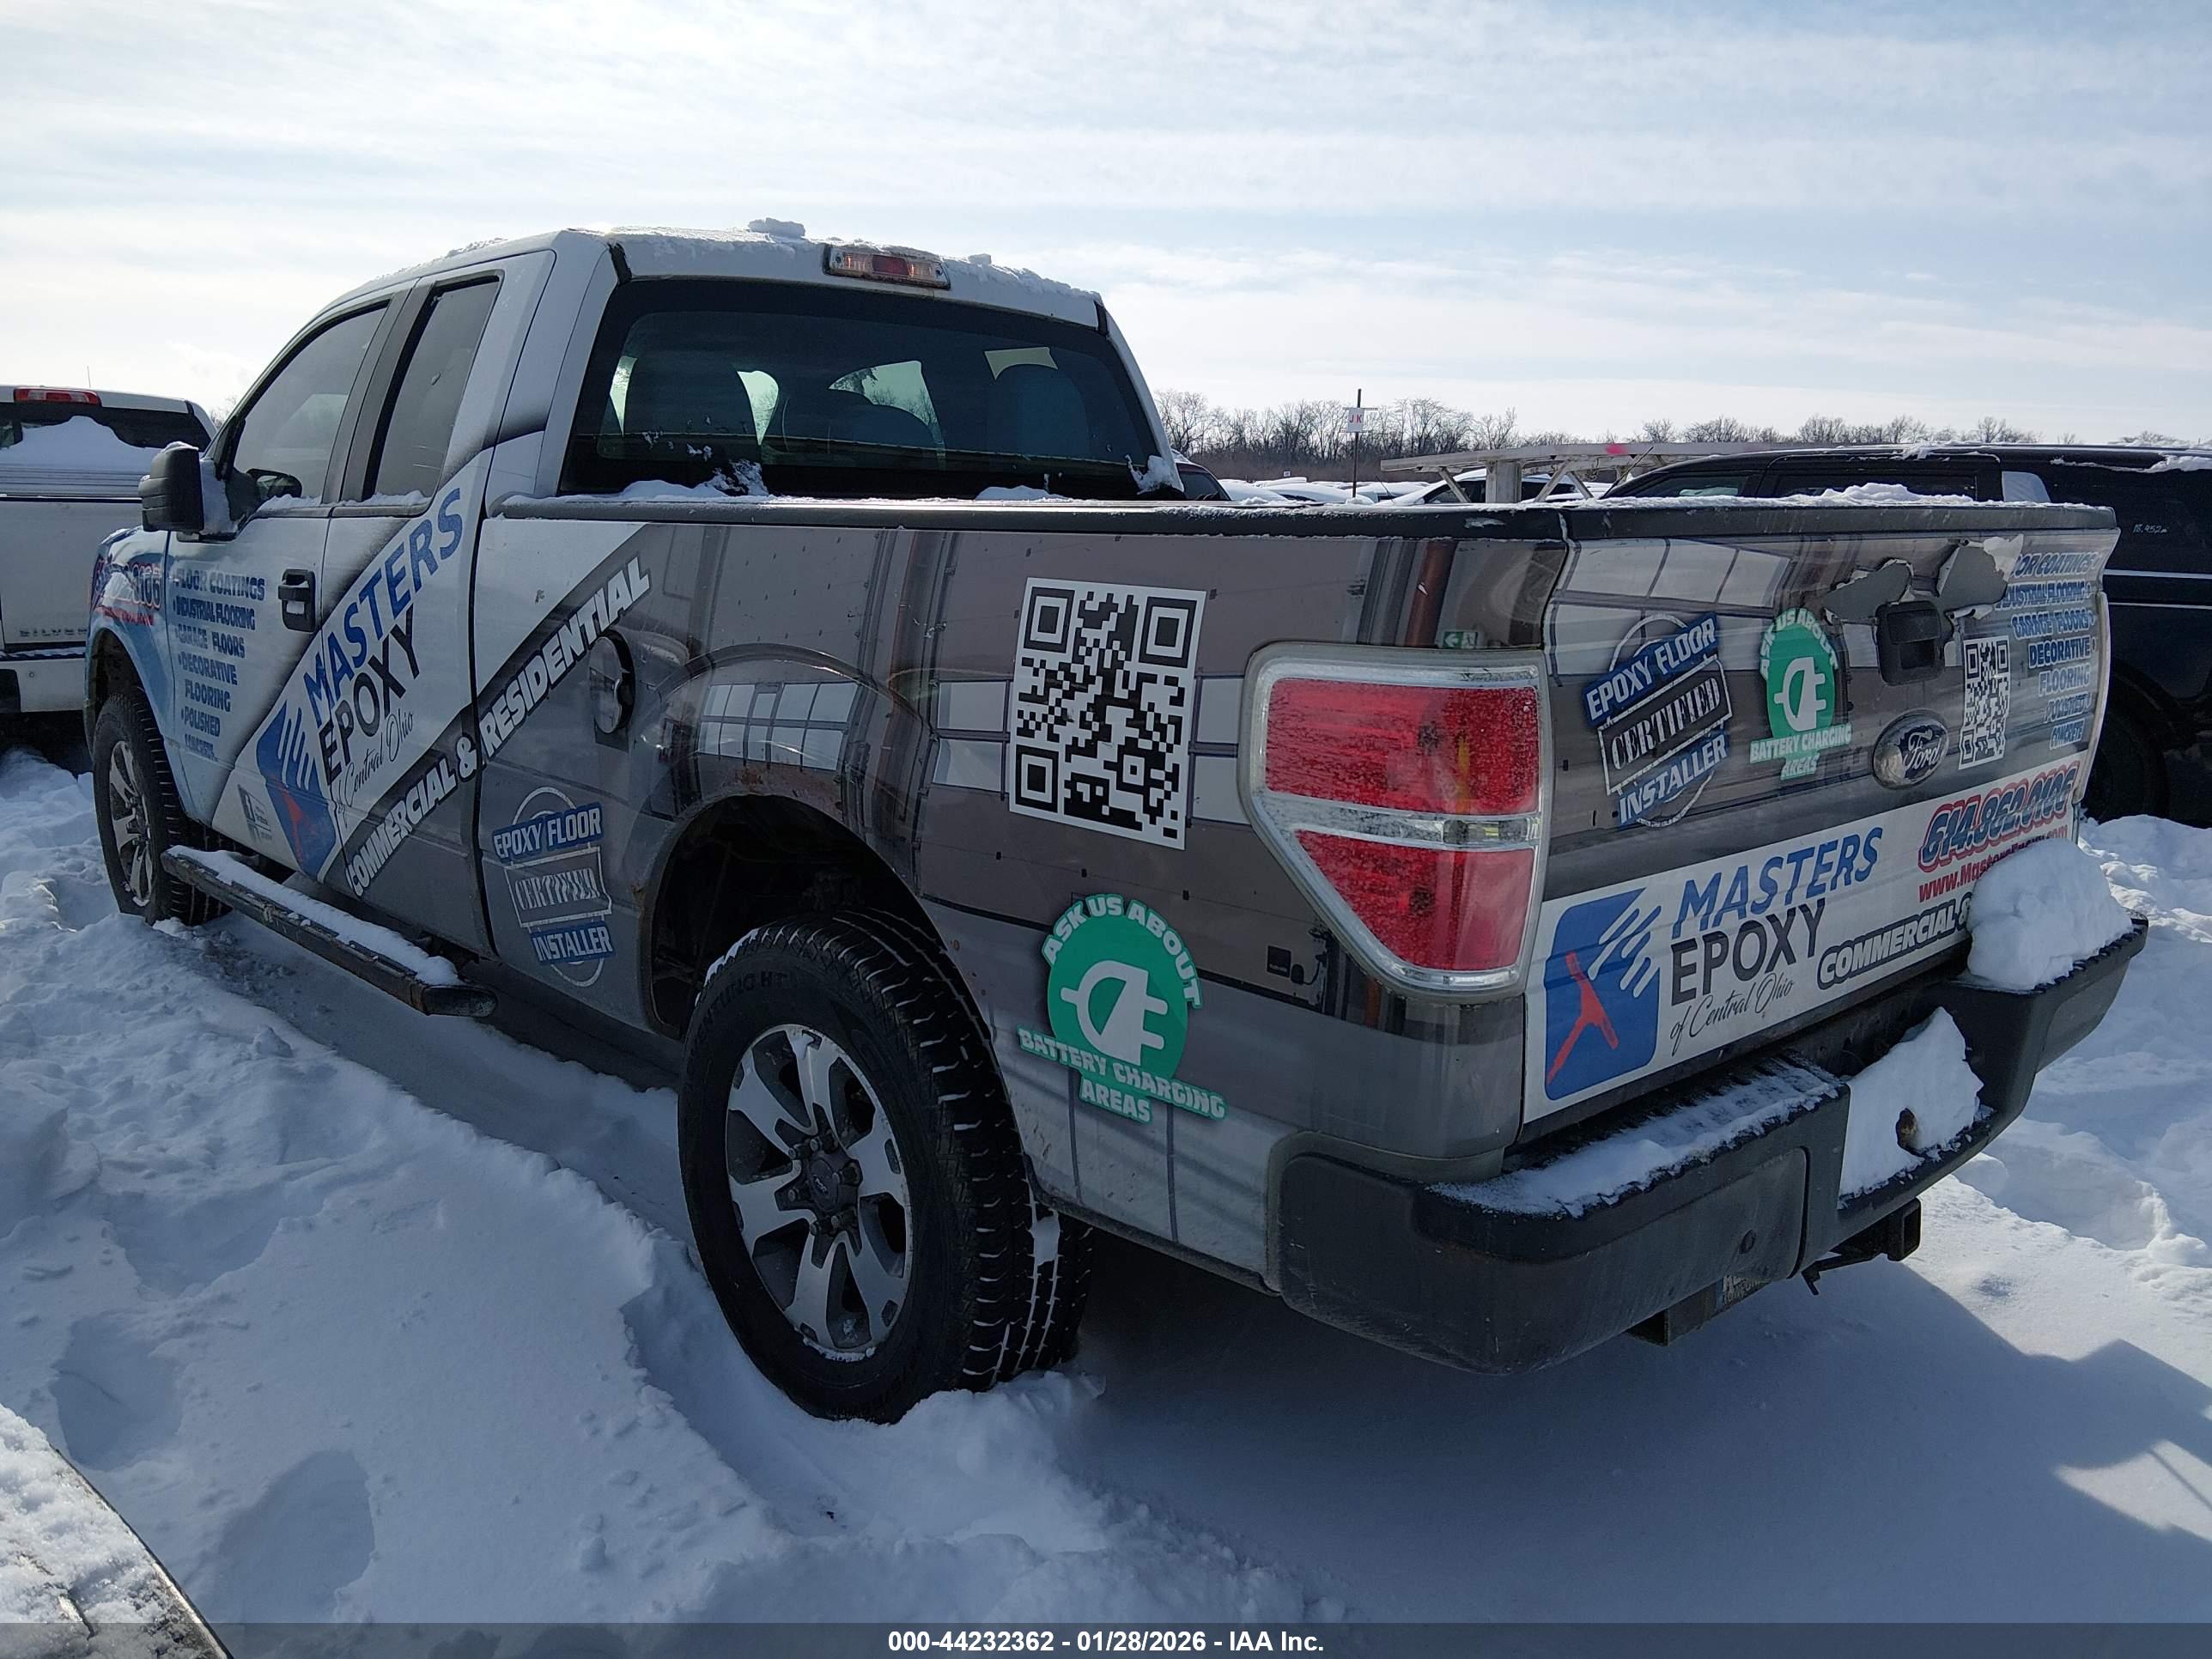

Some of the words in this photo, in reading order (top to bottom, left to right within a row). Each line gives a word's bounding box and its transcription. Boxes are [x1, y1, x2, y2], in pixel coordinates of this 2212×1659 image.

[175, 568, 207, 592] FLOOR
[210, 570, 265, 601] COATINGS
[303, 487, 463, 728] MASTERS
[176, 596, 216, 623] INDUSTRIAL
[216, 603, 256, 630] FLOORING
[2011, 611, 2053, 640] GARAGE
[211, 631, 245, 659] FLOORS
[1778, 611, 1795, 630] US
[1796, 608, 1838, 670] ABOUT
[2028, 636, 2091, 668] DECORATIVE
[180, 651, 238, 685] DECORATIVE
[1587, 657, 1653, 720] EPOXY
[1654, 617, 1717, 676] FLOOR
[2039, 663, 2091, 697] FLOORING
[185, 678, 231, 712] FLOORING
[319, 603, 420, 786] EPOXY
[184, 706, 221, 737] POLISHED
[347, 757, 457, 897] COMMERCIAL
[456, 737, 481, 781] &
[480, 556, 651, 757] RESIDENTIAL
[1611, 678, 1720, 770] CERTIFIED
[1750, 735, 1800, 763] BATTERY
[1800, 724, 1852, 752] CHARGING
[344, 732, 383, 807] Central
[386, 708, 414, 763] Ohio
[1780, 750, 1820, 780] AREAS
[1903, 729, 1942, 771] Ford
[1619, 734, 1728, 824] INSTALLER
[494, 823, 542, 859] EPOXY
[548, 808, 601, 847] FLOOR
[1918, 761, 2079, 871] 614.862.0106
[516, 867, 600, 910] CERTIFIED
[1672, 827, 1883, 939] MASTERS
[532, 927, 614, 962] INSTALLER
[1041, 902, 1088, 966] ASK
[1087, 895, 1124, 917] US
[1127, 899, 1202, 1008] ABOUT
[1671, 897, 1826, 1006] EPOXY
[1819, 902, 1956, 986] COMMERCIAL
[1670, 1005, 1692, 1057] of
[1689, 990, 1752, 1038] Central
[1754, 972, 1795, 1014] Ohio
[1018, 1028, 1108, 1076] BATTERY
[1113, 1061, 1226, 1118] CHARGING
[1080, 1079, 1152, 1122] AREAS
